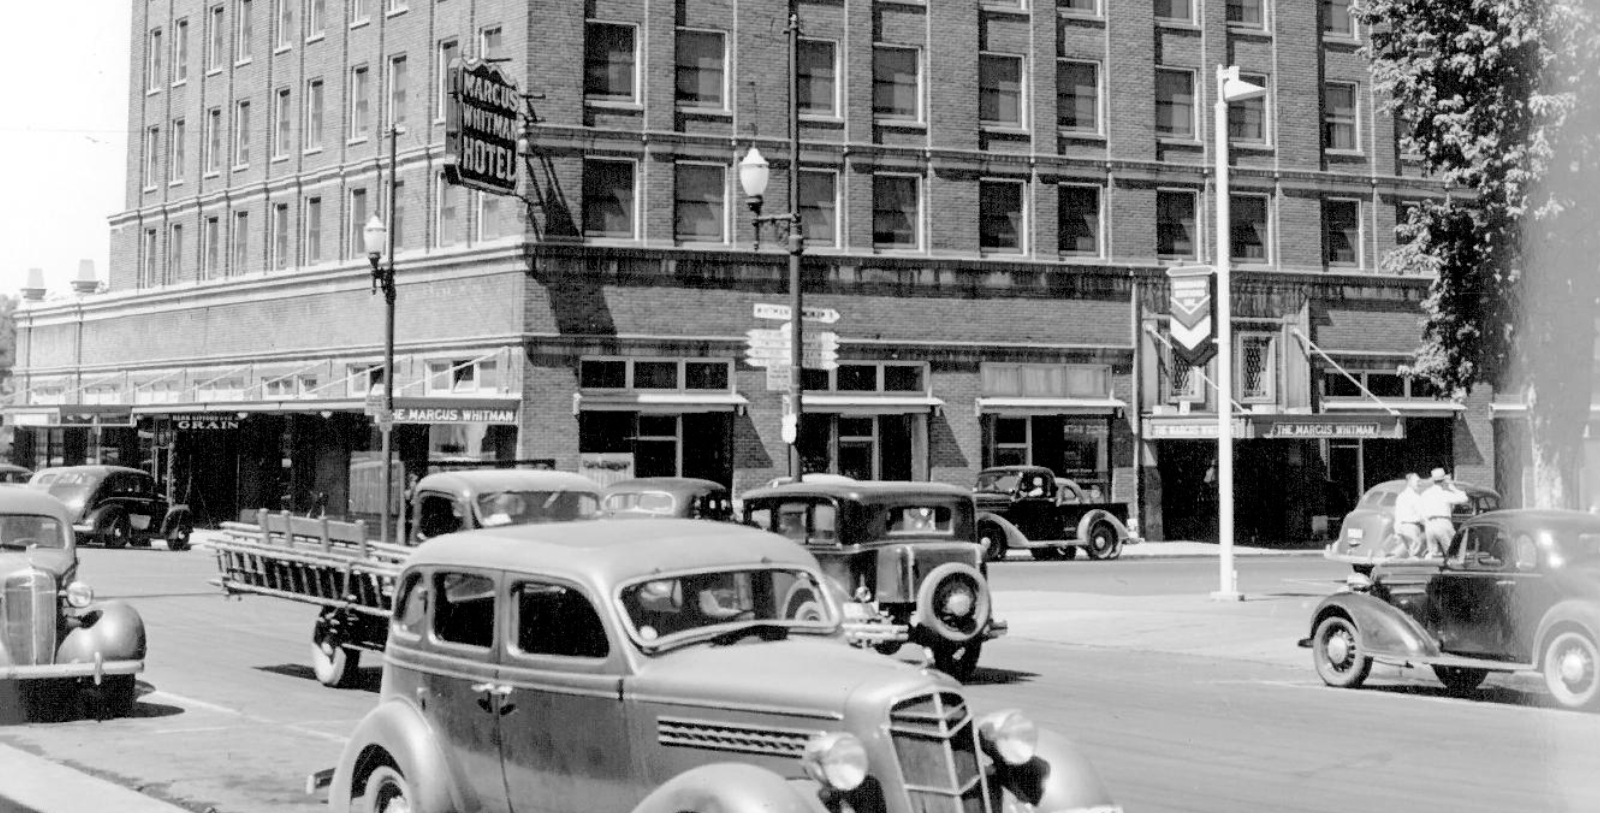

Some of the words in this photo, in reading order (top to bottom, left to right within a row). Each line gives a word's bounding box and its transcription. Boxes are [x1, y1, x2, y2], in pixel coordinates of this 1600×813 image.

[463, 72, 518, 112] MARCUS
[463, 103, 517, 141] WHITMAN
[463, 135, 517, 182] HOTEL
[178, 420, 239, 429] GRAIN
[392, 408, 405, 420] HE
[409, 408, 458, 420] MARCUS
[462, 409, 514, 421] WHITMAN
[1276, 424, 1293, 435] THE
[1295, 424, 1333, 435] MARCUS
[1335, 425, 1375, 435] WHITMAN
